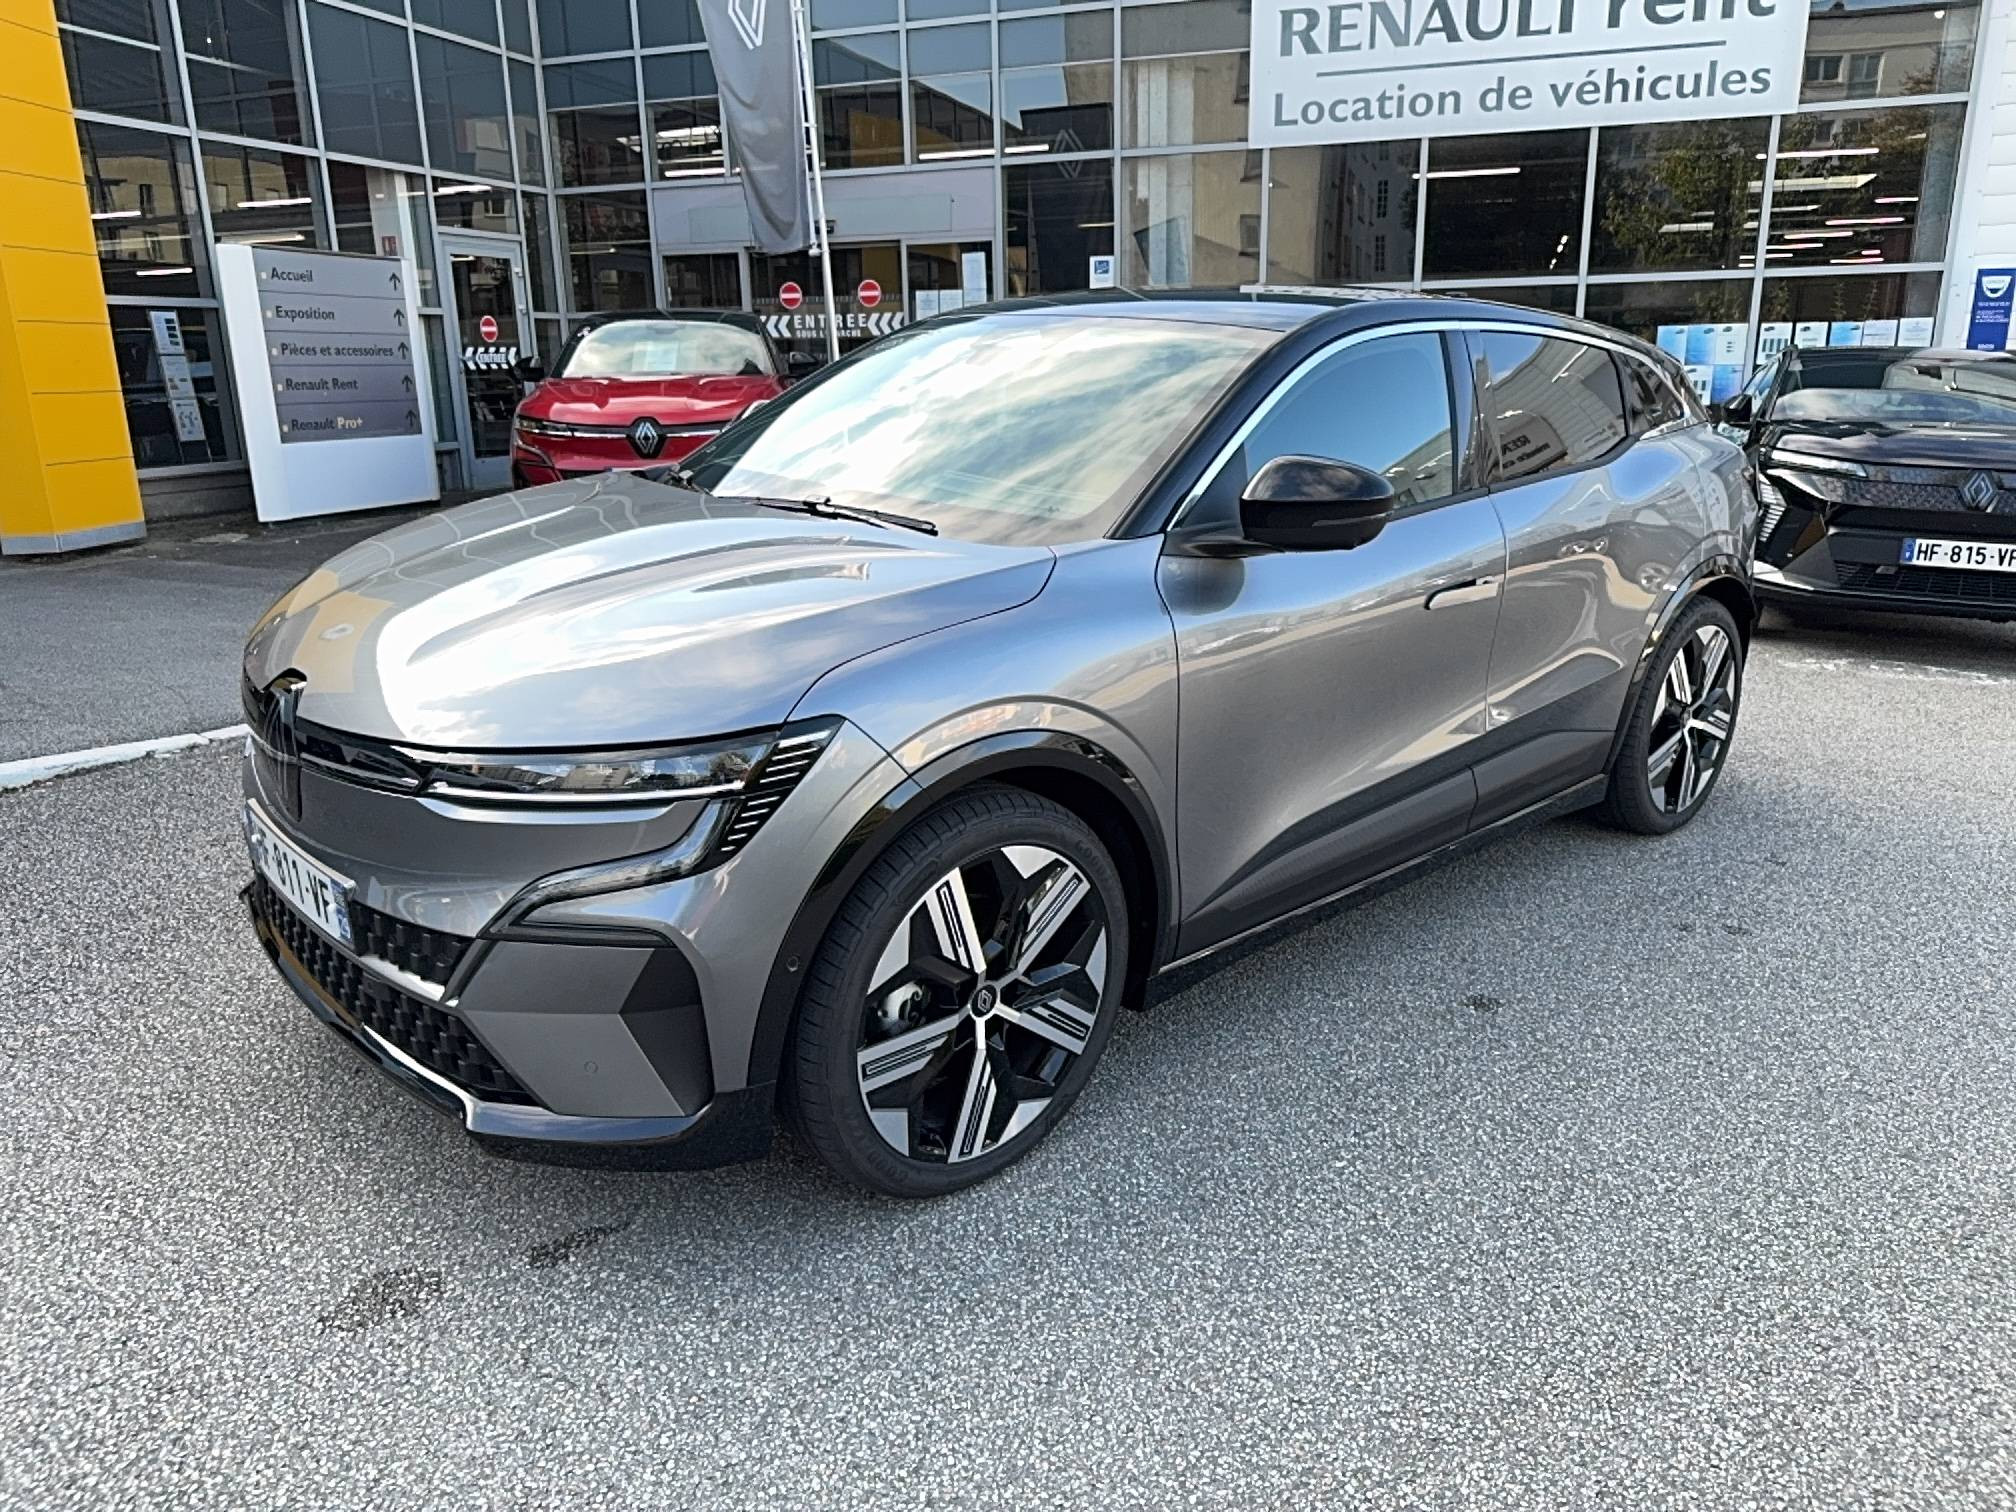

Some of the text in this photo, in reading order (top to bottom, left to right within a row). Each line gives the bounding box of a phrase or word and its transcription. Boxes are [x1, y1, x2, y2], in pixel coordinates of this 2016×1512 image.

[1274, 60, 1771, 127] Location de véhicules
[270, 266, 313, 283] Accueil
[275, 305, 335, 323] Exposition
[280, 342, 394, 357] Pièces et accessoires
[285, 377, 359, 391] Renault Rent
[291, 416, 363, 432] Renault Pro+
